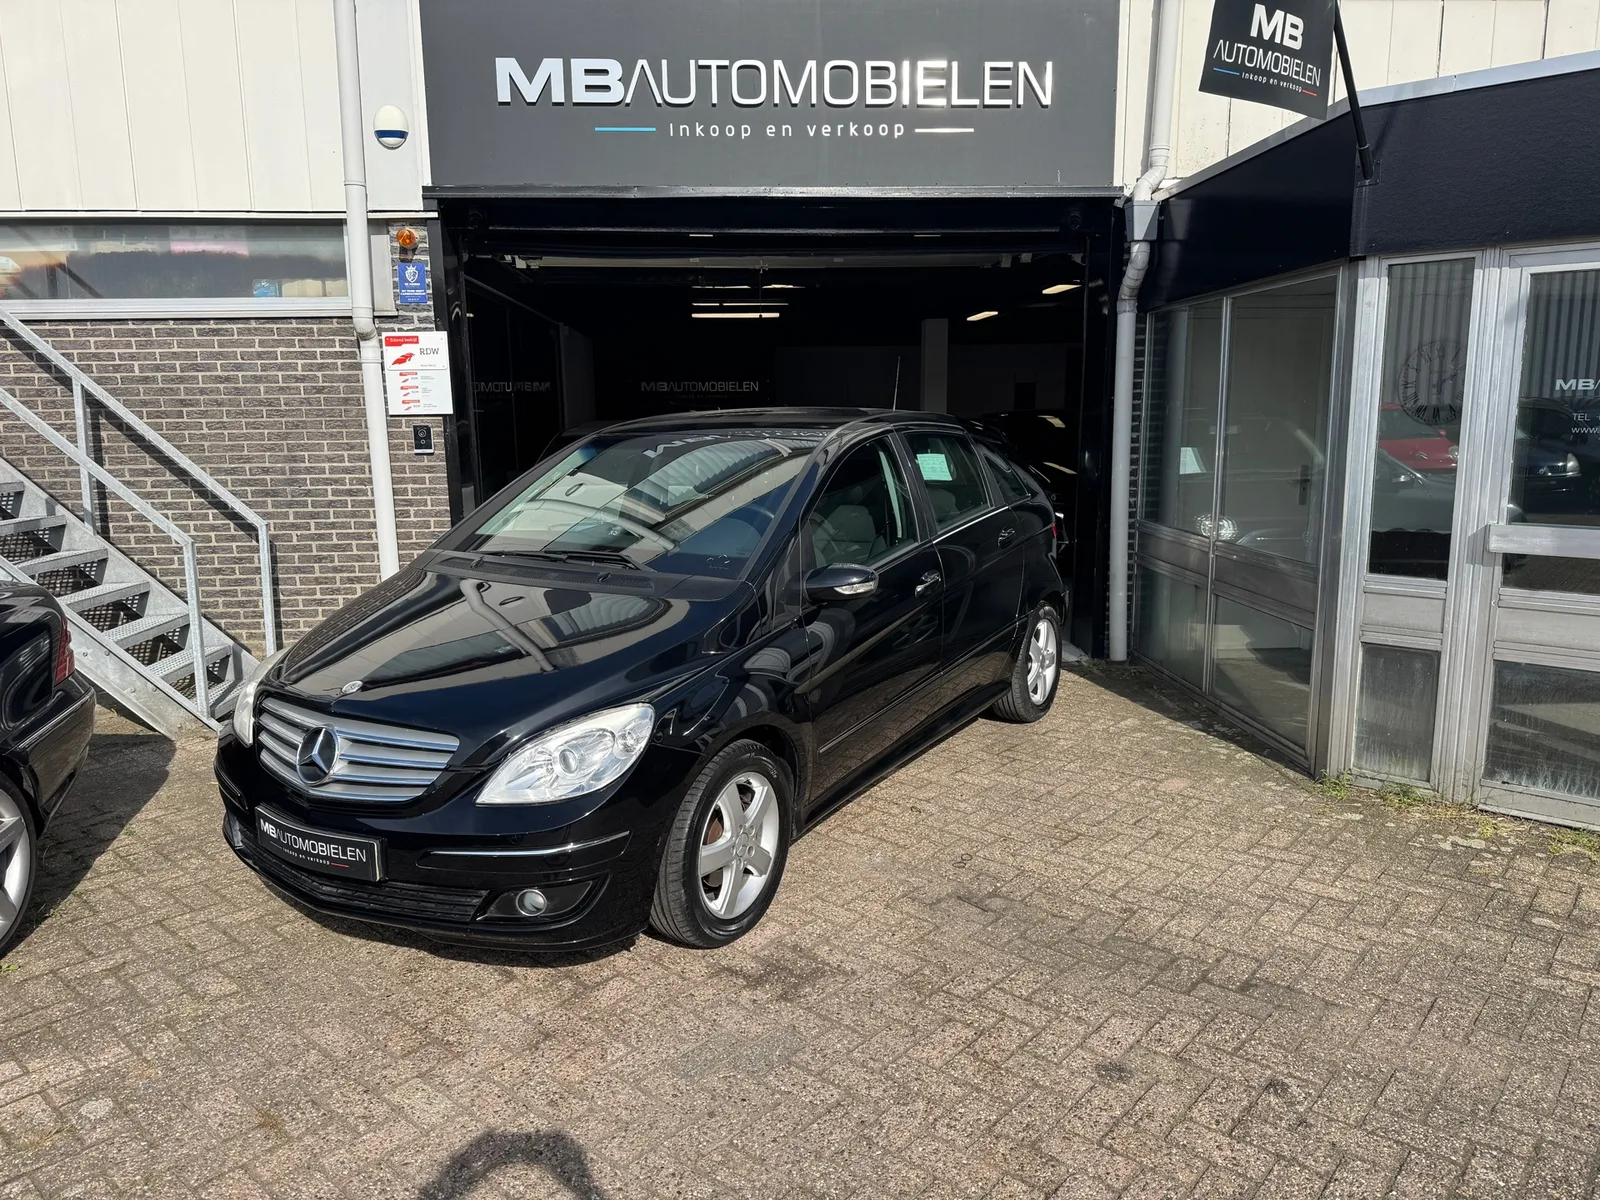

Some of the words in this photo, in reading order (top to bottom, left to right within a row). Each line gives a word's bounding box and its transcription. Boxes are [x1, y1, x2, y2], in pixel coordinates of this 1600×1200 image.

[1250, 3, 1304, 50] MB
[1213, 39, 1321, 87] AUTOMOBIELEN
[1269, 77, 1278, 85] en
[1280, 80, 1303, 93] verkoop
[766, 124, 792, 137] en
[806, 121, 905, 139] verkoop
[419, 347, 440, 356] RDW
[1572, 412, 1591, 421] TEL
